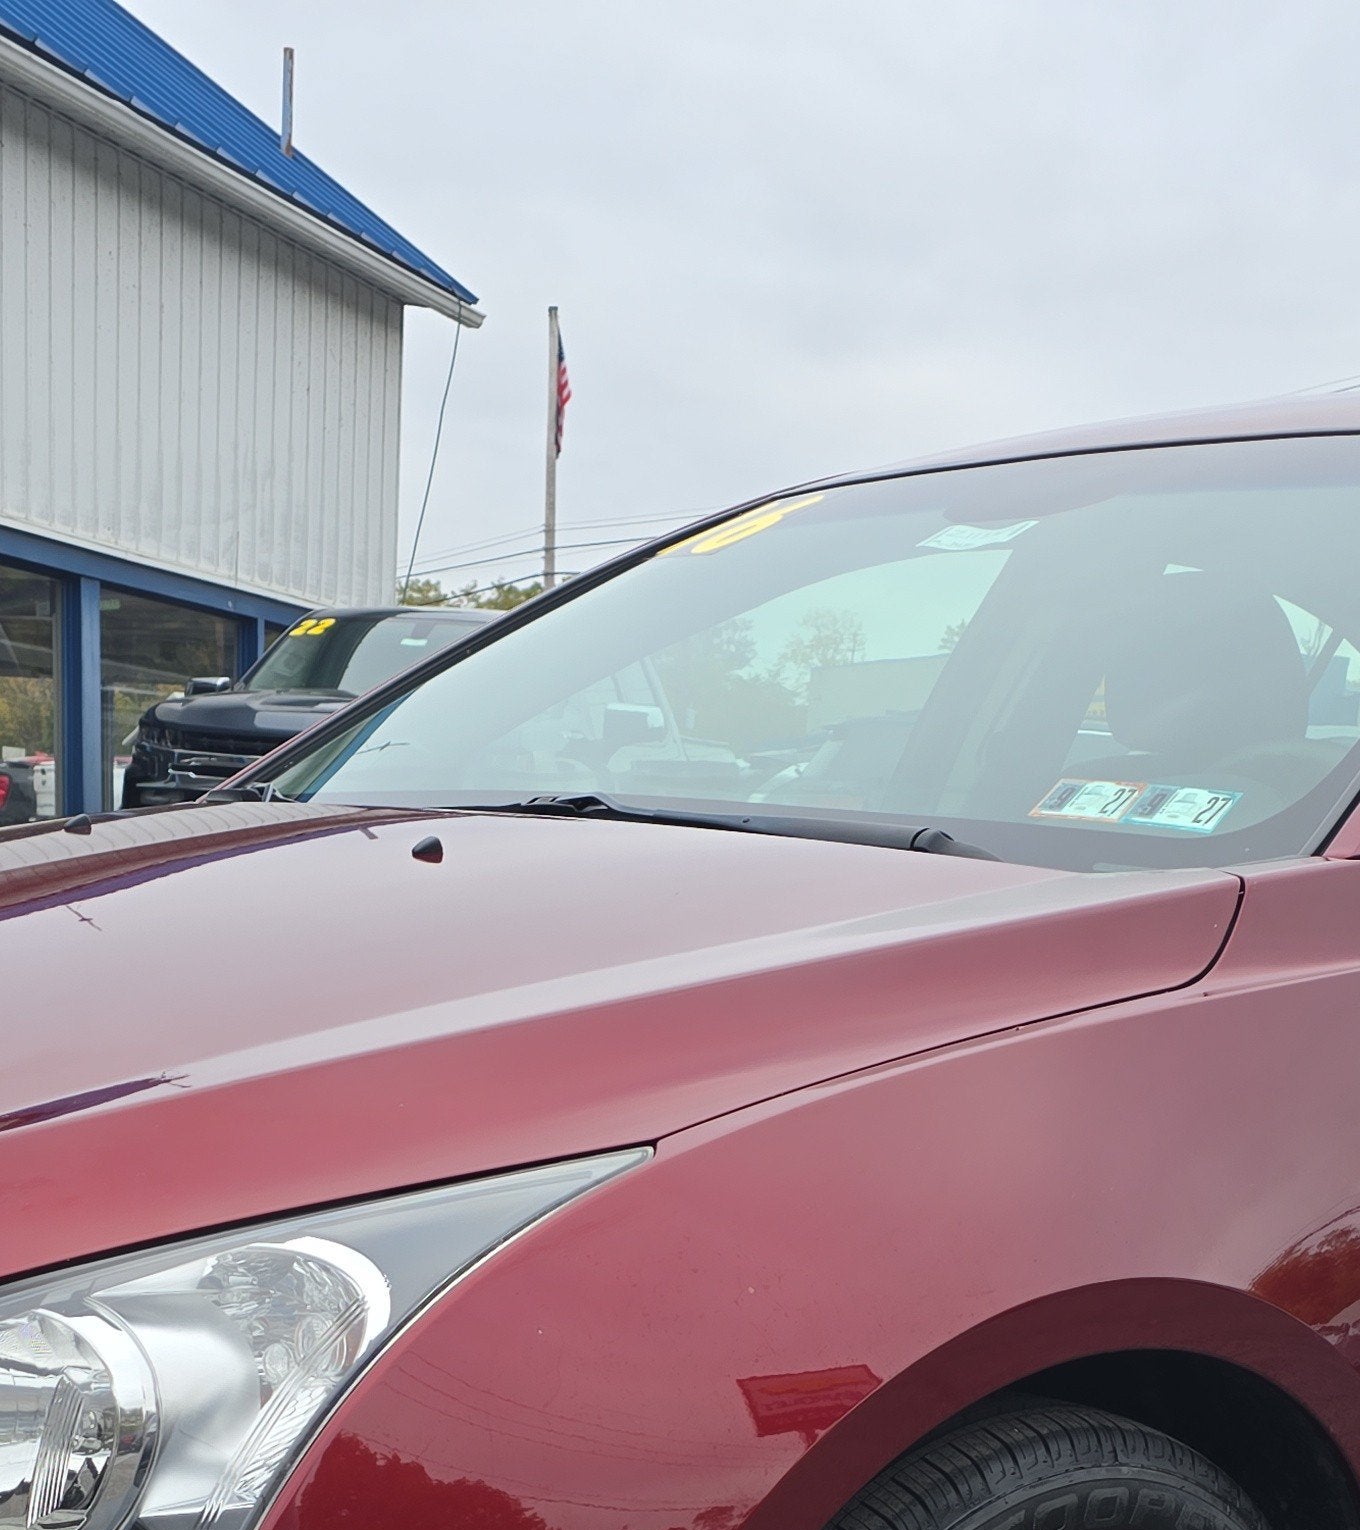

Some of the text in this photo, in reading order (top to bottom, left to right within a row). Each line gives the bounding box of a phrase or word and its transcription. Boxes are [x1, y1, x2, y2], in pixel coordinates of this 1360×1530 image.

[289, 617, 336, 637] 22
[1098, 788, 1139, 815] 27
[1192, 796, 1233, 825] 27
